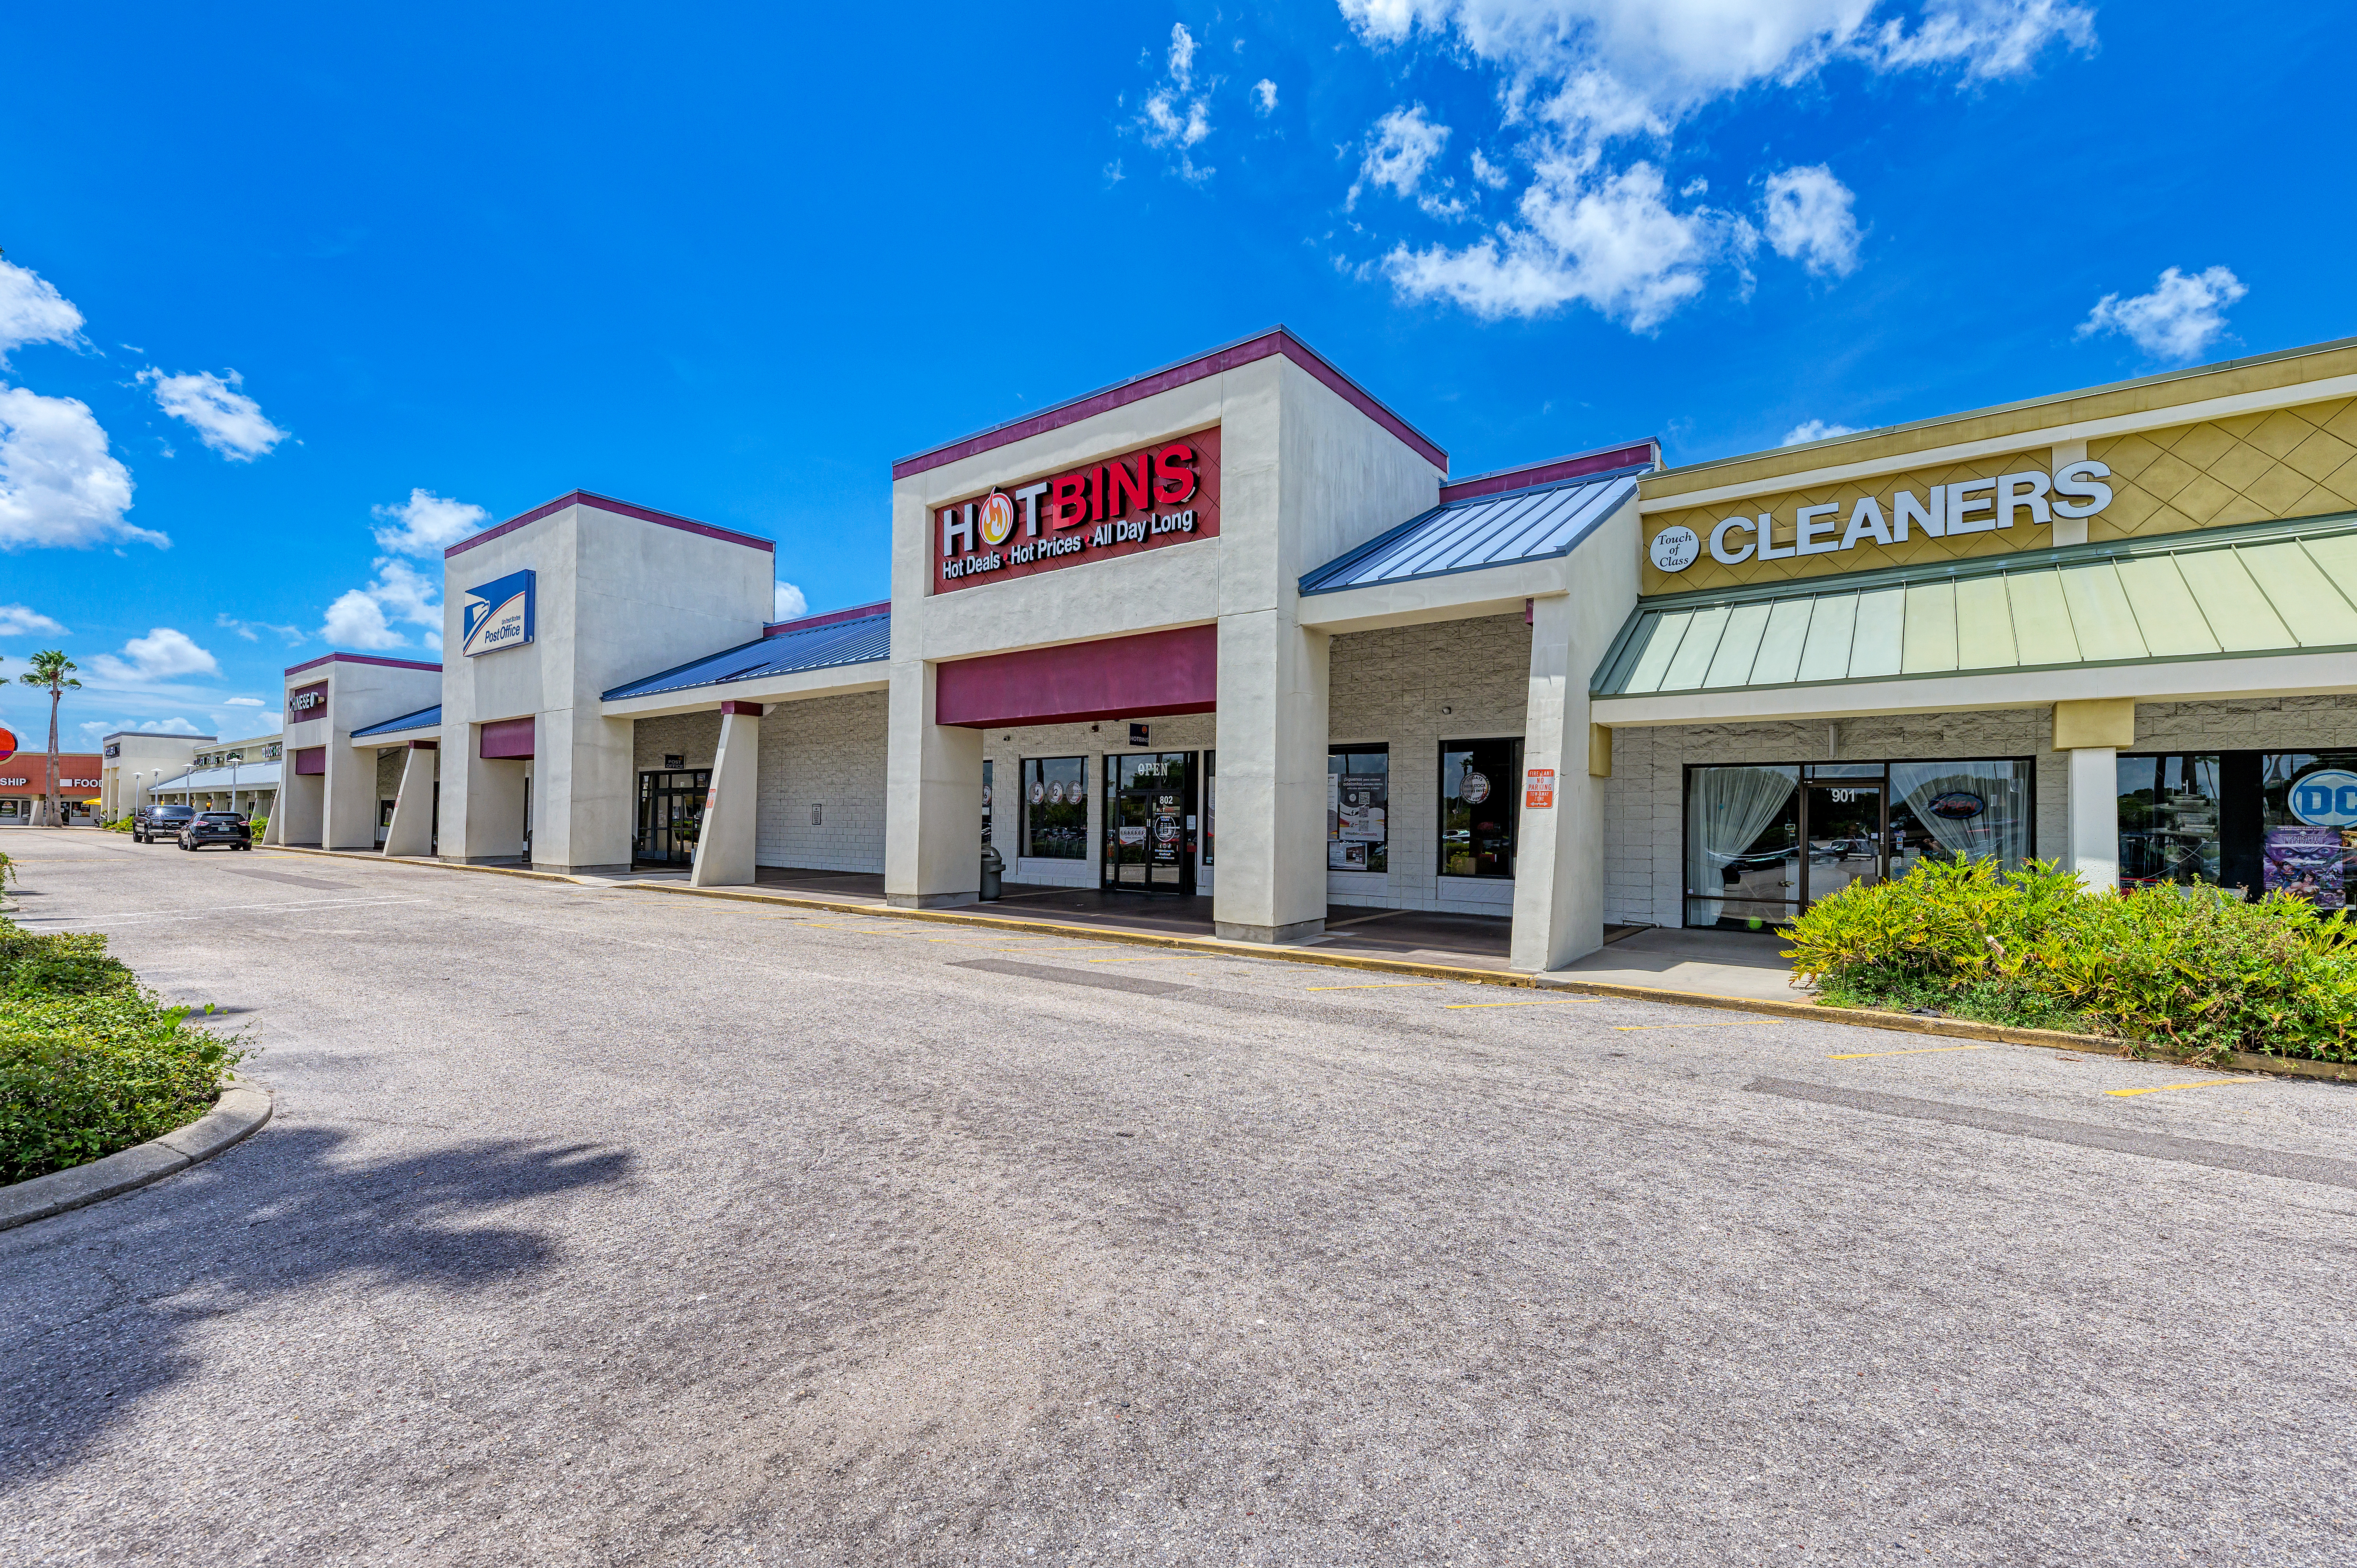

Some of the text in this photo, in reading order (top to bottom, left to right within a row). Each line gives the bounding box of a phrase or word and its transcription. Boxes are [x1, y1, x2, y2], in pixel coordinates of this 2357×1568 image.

[944, 444, 1195, 556] HOTBINS
[1709, 460, 2113, 565] CLEANERS
[943, 510, 1193, 580] Hot Deals Hot Prices All Day Long
[1658, 532, 1692, 545] Touch
[1669, 543, 1680, 556] of
[1659, 556, 1689, 567] Class
[485, 624, 520, 644] Post Office
[289, 693, 310, 712] CHINESE
[1138, 763, 1167, 776] OPEN
[1160, 796, 1173, 804] 802
[1832, 789, 1854, 802] 901
[2298, 786, 2357, 815] DC
[1936, 800, 1977, 811] OPEN
